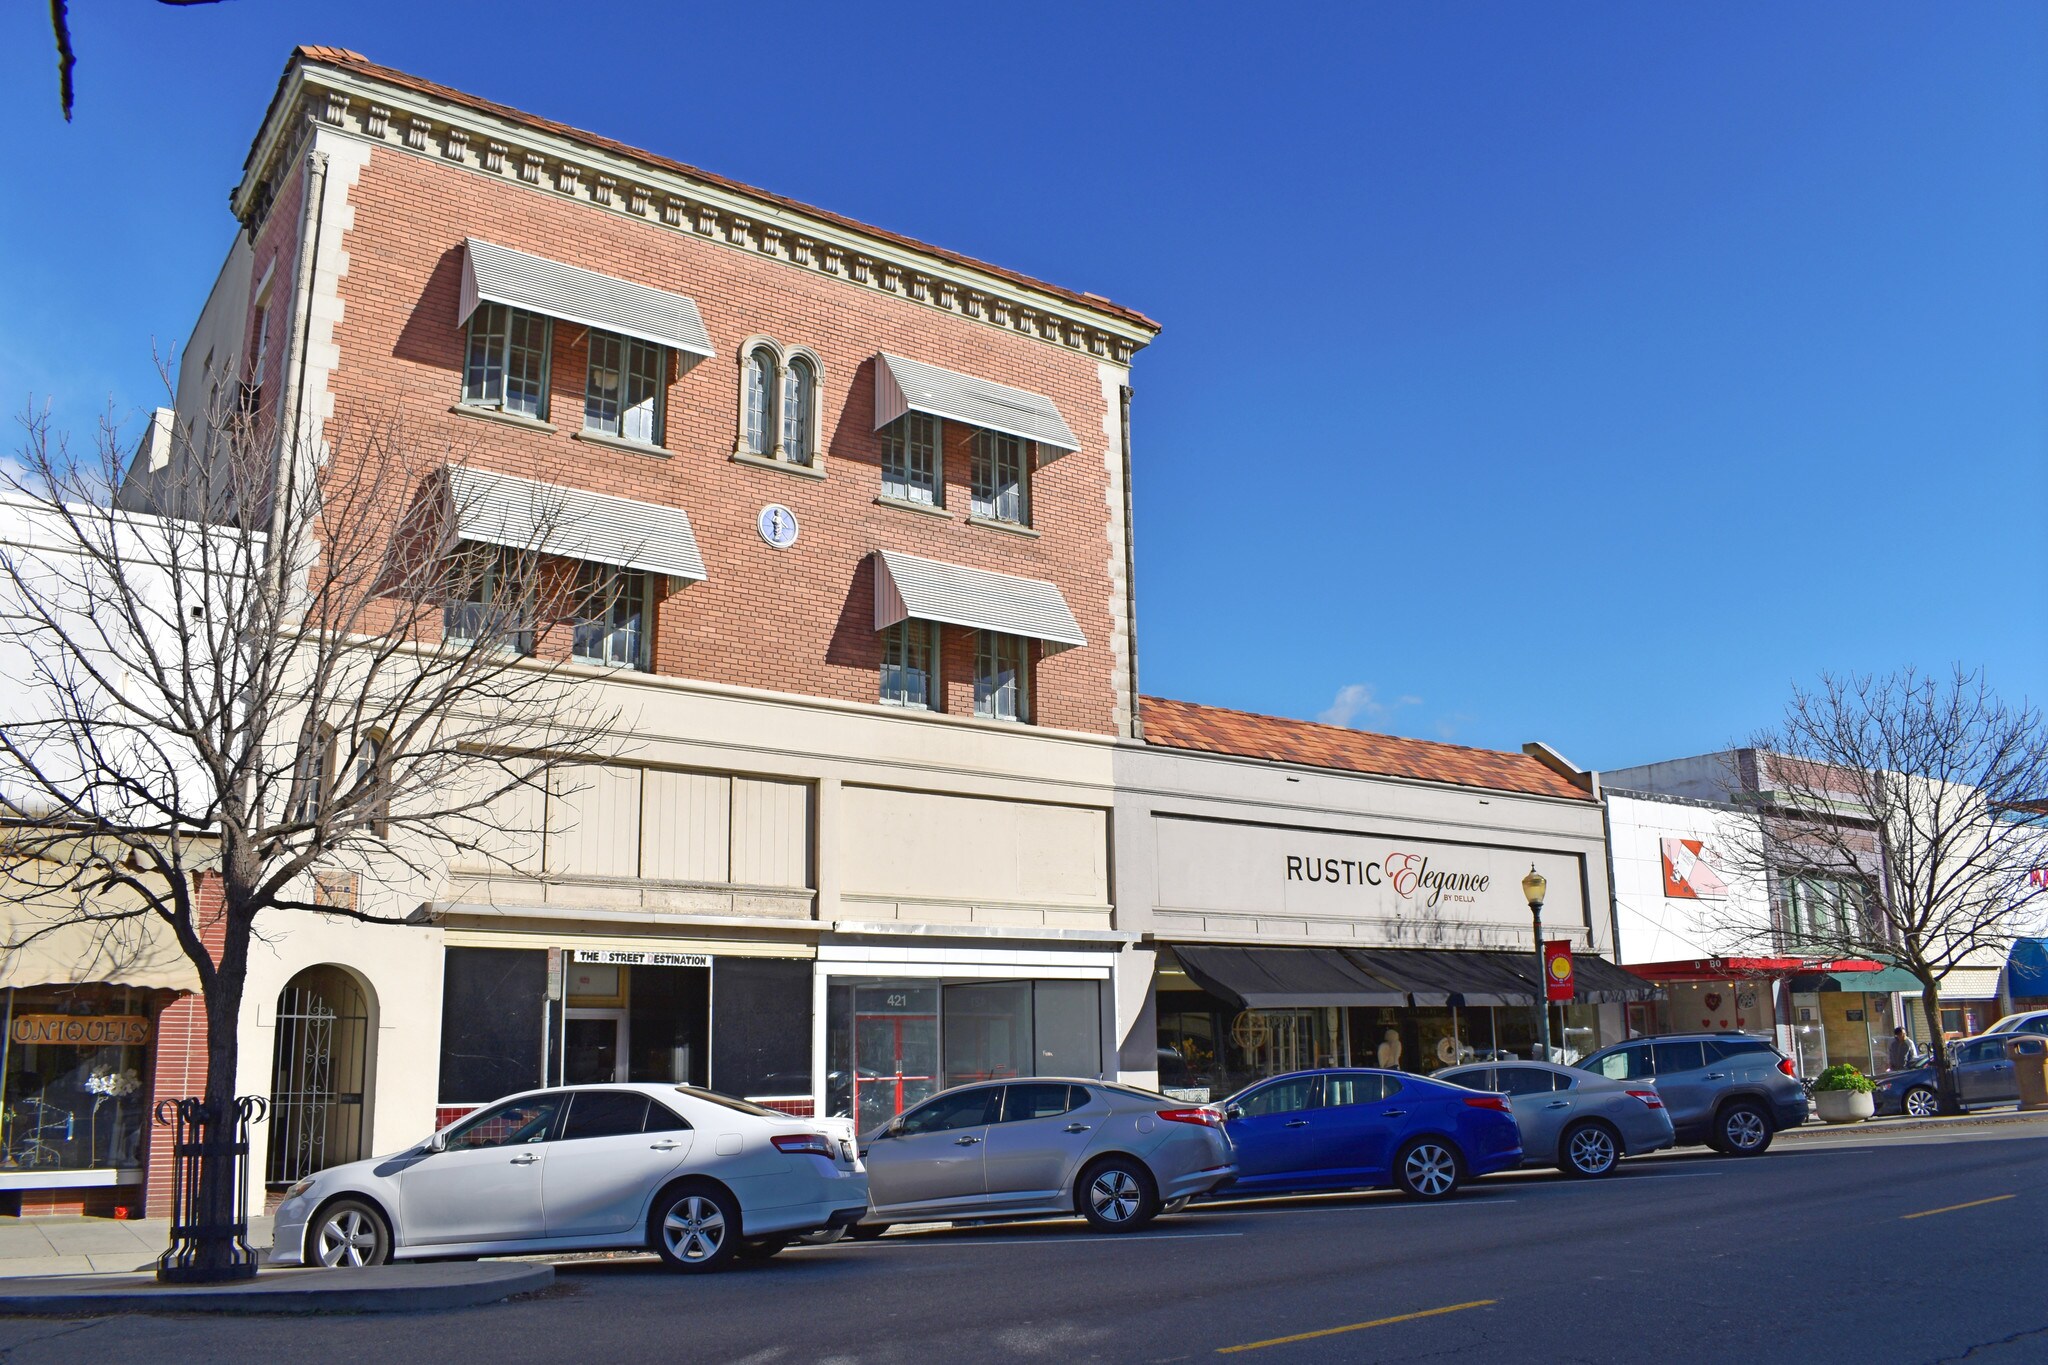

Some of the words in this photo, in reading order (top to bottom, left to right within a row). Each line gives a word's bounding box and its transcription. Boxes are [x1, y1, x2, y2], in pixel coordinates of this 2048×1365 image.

[1286, 855, 1382, 886] RUSTIC
[1384, 852, 1490, 908] Elegance
[1443, 894, 1453, 902] BY
[1454, 894, 1476, 903] DELLA
[580, 951, 599, 961] THE
[608, 952, 646, 964] STREET
[887, 994, 906, 1007] 421
[14, 1019, 149, 1042] UNIQUELY
